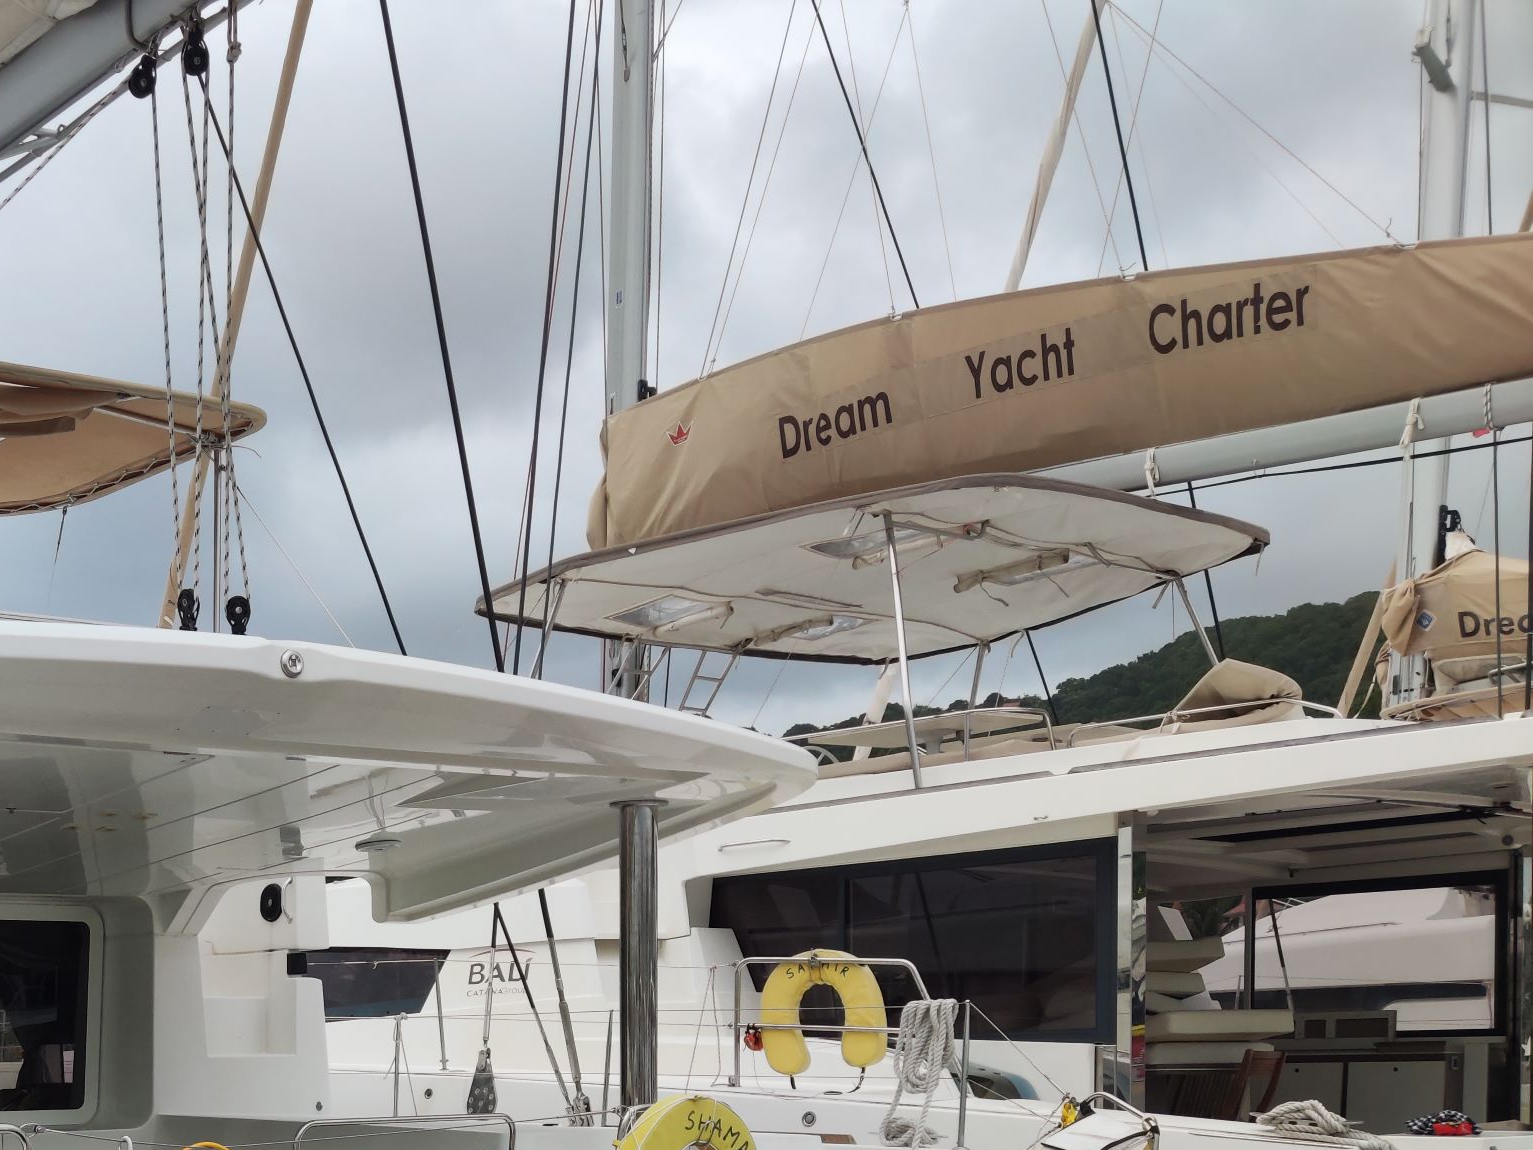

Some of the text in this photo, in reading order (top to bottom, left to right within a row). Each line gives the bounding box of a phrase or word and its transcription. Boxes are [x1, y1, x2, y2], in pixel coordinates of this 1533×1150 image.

[778, 281, 1311, 460] Dream Yacht Charter
[786, 962, 850, 979] SAHIR
